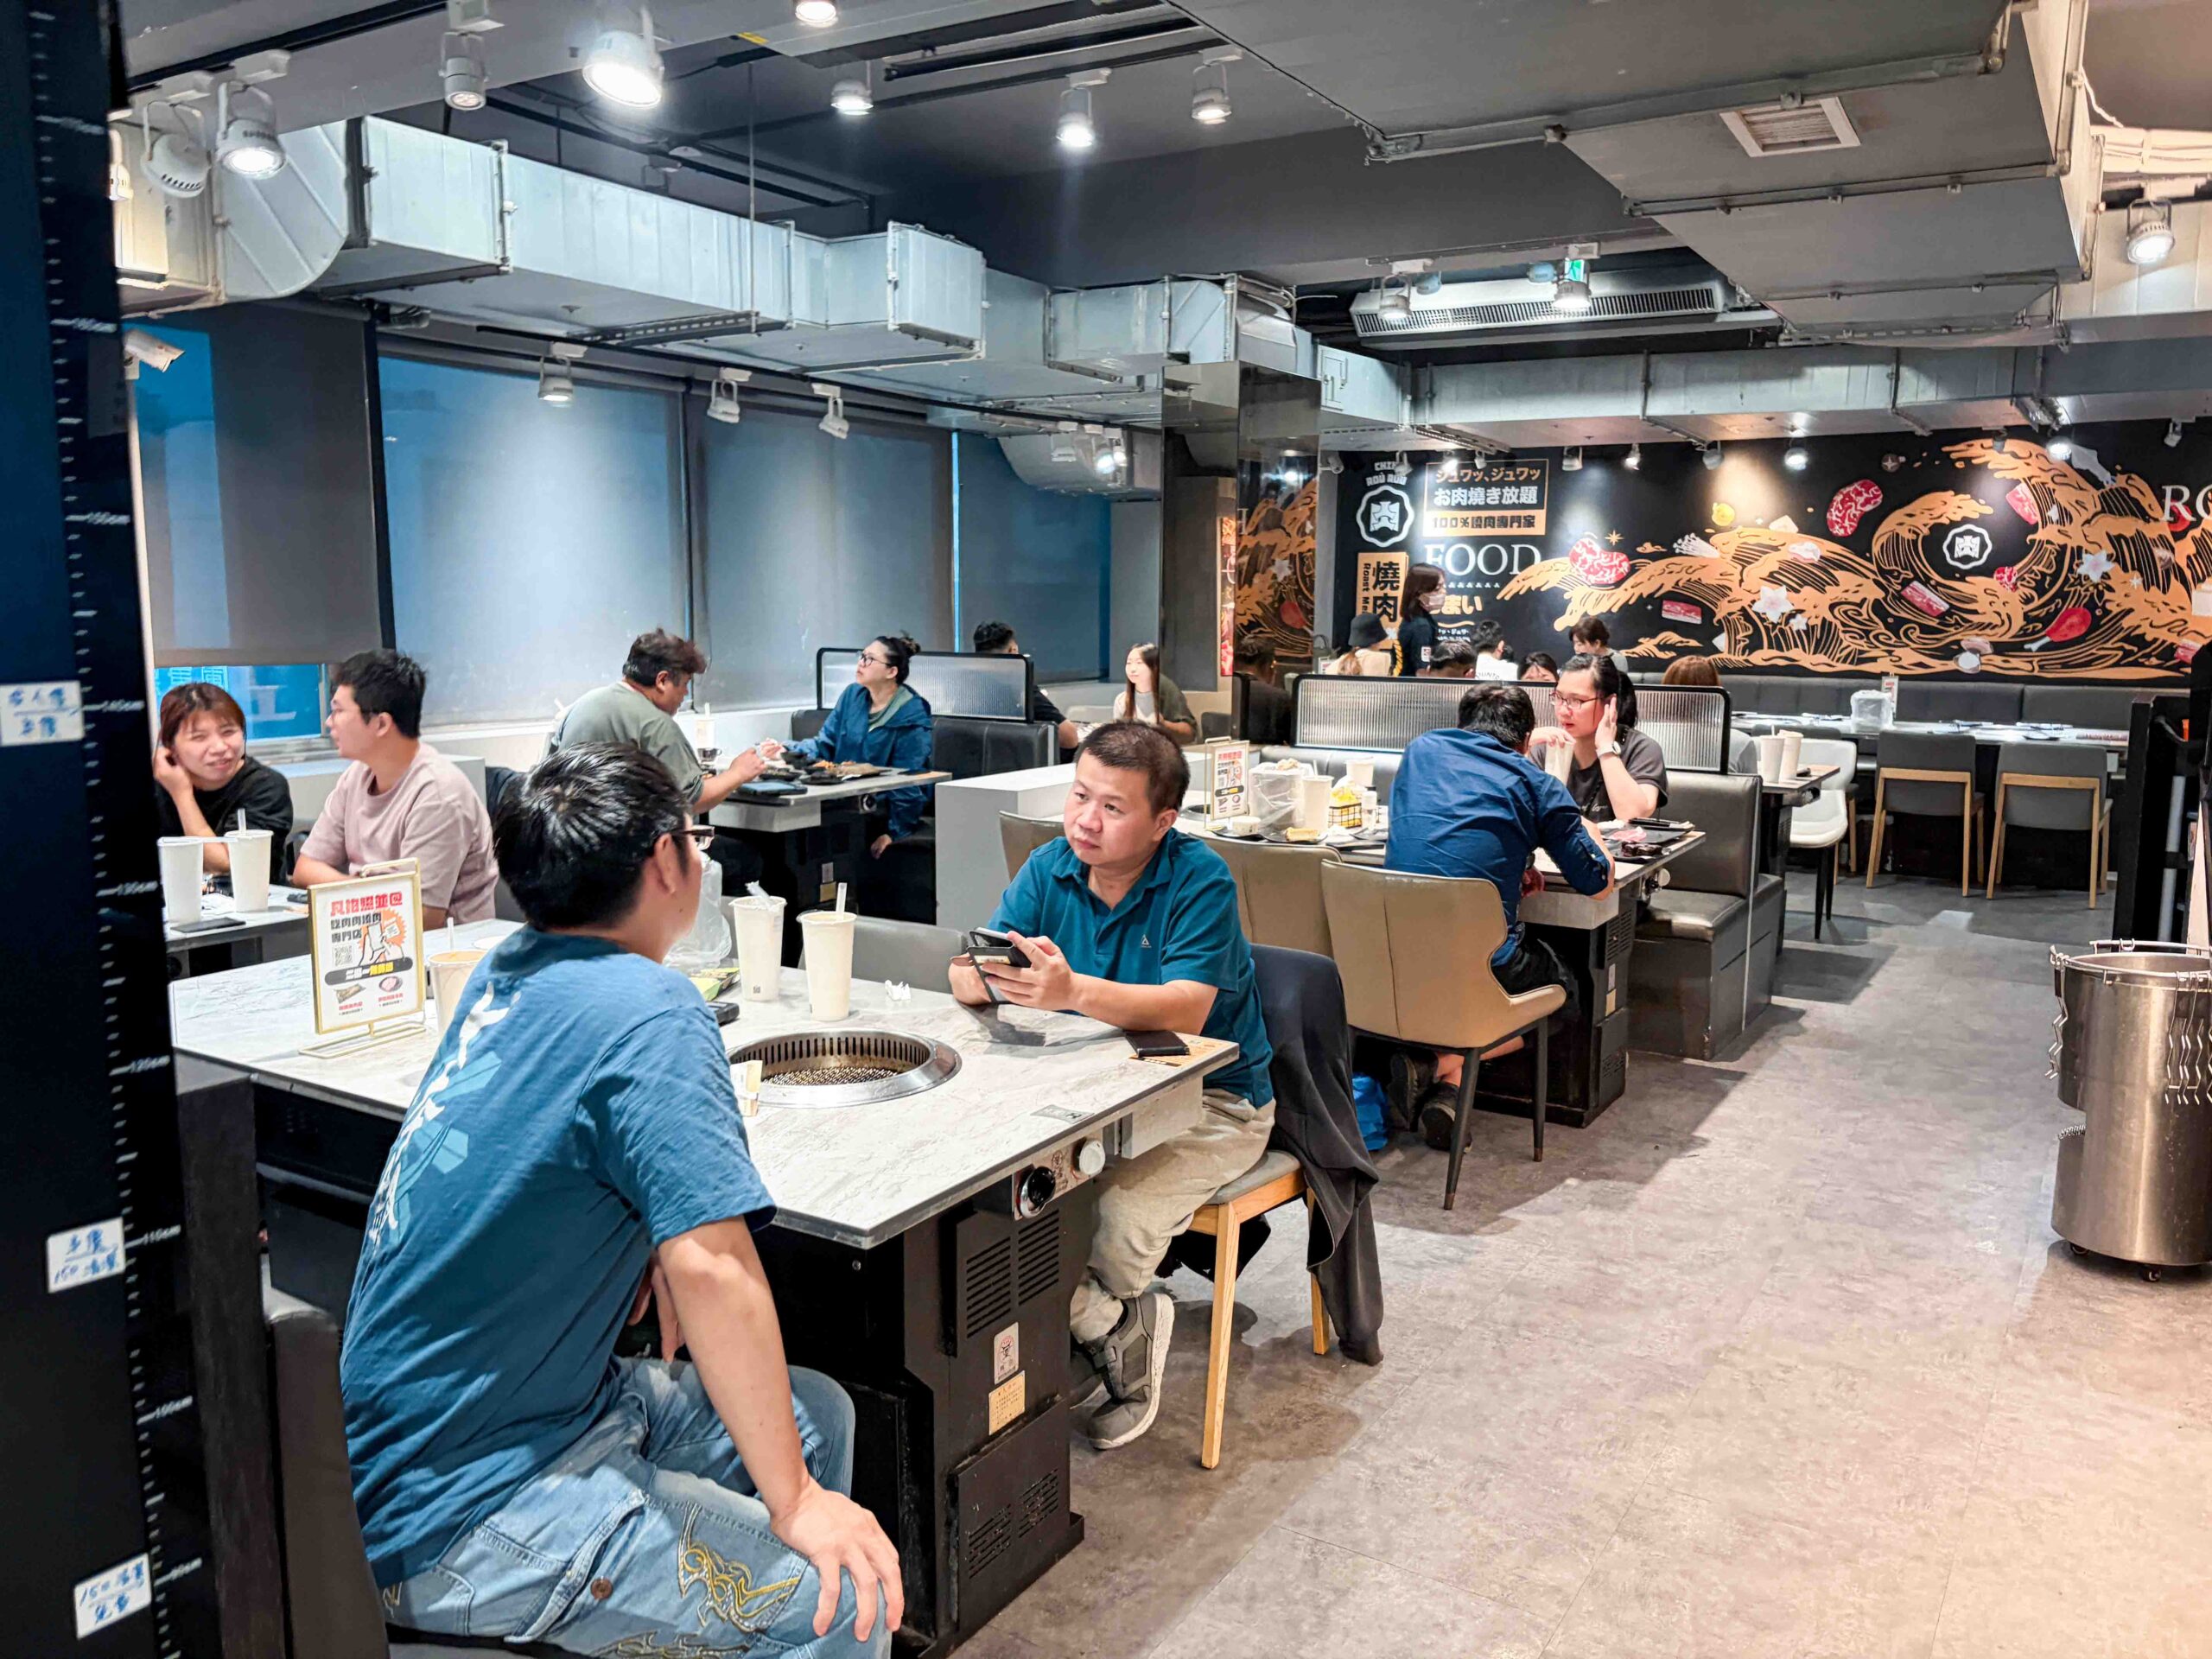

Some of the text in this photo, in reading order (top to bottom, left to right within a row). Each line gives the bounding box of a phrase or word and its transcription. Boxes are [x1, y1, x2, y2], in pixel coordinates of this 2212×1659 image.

[1424, 543, 1541, 576] FOOD
[1372, 561, 1400, 622] 燒肉
[1430, 594, 1484, 615] まい
